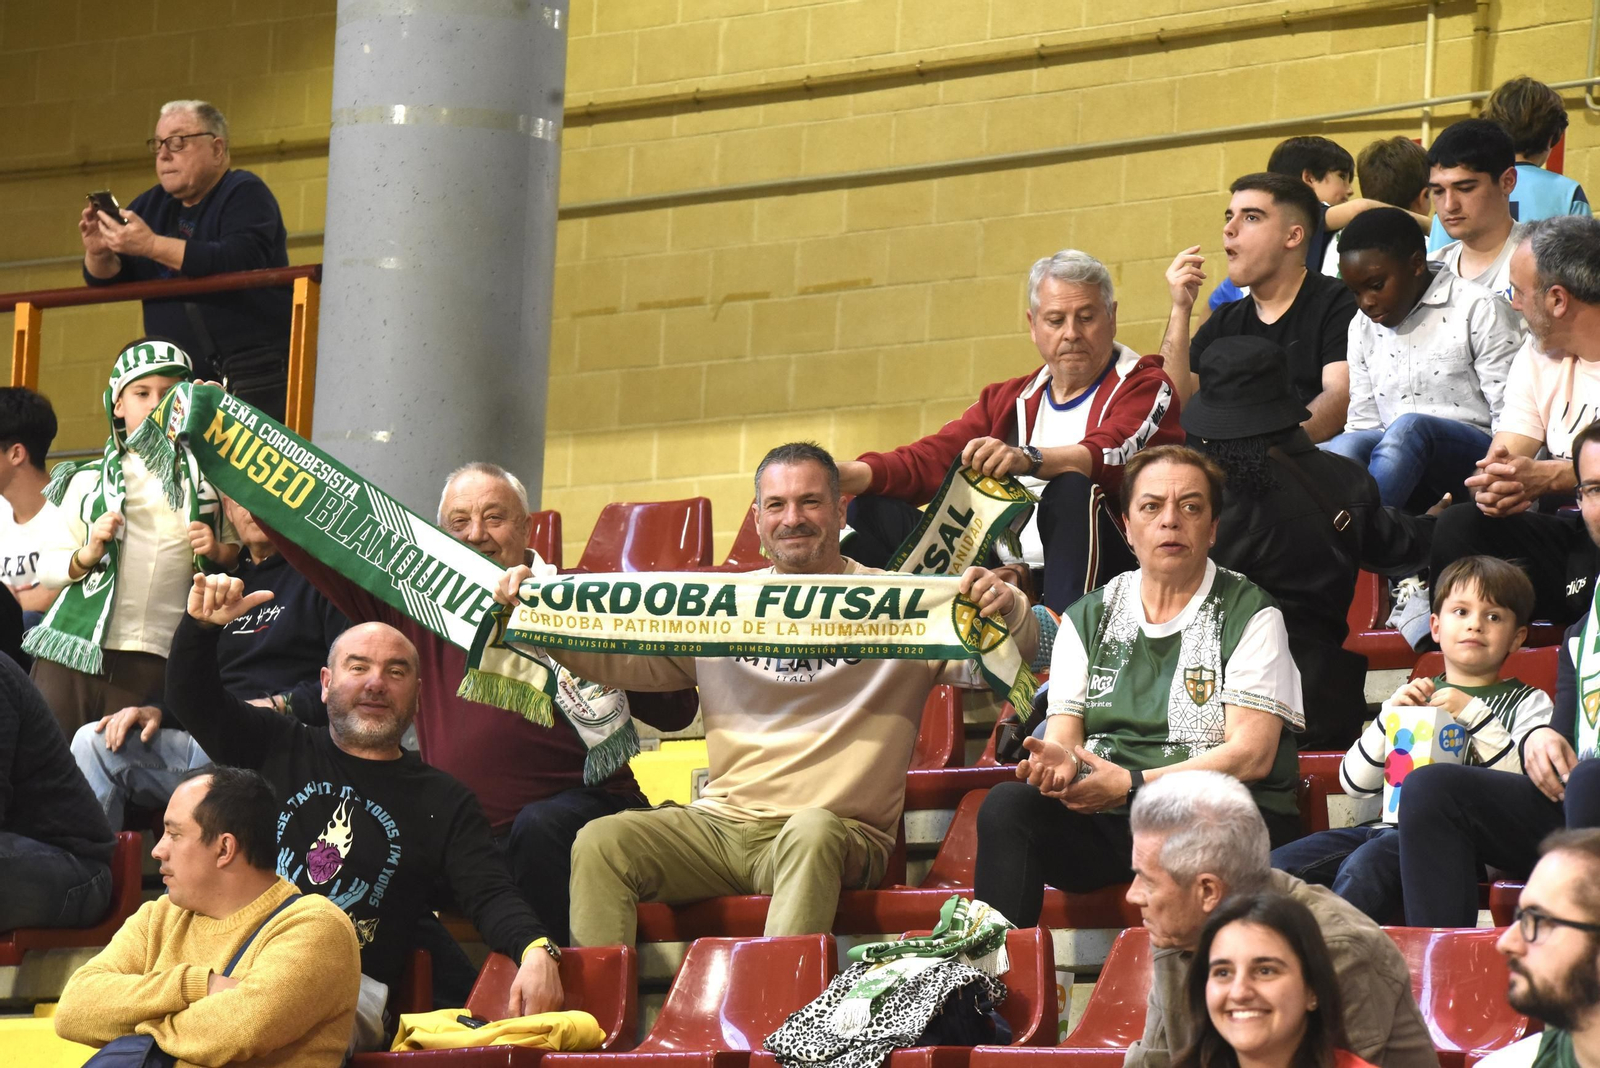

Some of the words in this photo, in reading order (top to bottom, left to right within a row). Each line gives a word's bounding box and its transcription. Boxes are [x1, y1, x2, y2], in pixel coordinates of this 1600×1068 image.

[203, 408, 316, 510] MUSEO
[219, 393, 260, 430] PEÑA
[258, 422, 361, 501] CORDOBESISTA
[516, 576, 738, 617] CÓRDOBA
[755, 585, 932, 620] FUTSAL
[519, 609, 604, 631] CÓRDOBA
[613, 618, 732, 635] PATRIMONIO
[743, 620, 766, 635] DE
[776, 621, 799, 636] LA
[811, 622, 926, 637] HUMANIDAD
[514, 630, 564, 645] PRIMERA
[567, 639, 616, 650] DIVISIÓN
[729, 645, 780, 654] PRIMERA
[785, 644, 836, 654] DIVISIÓN
[776, 673, 817, 683] ITALY
[1090, 674, 1113, 691] RG3
[1442, 729, 1459, 739] POP
[1443, 737, 1464, 749] CORN
[369, 867, 396, 908] YOURS
